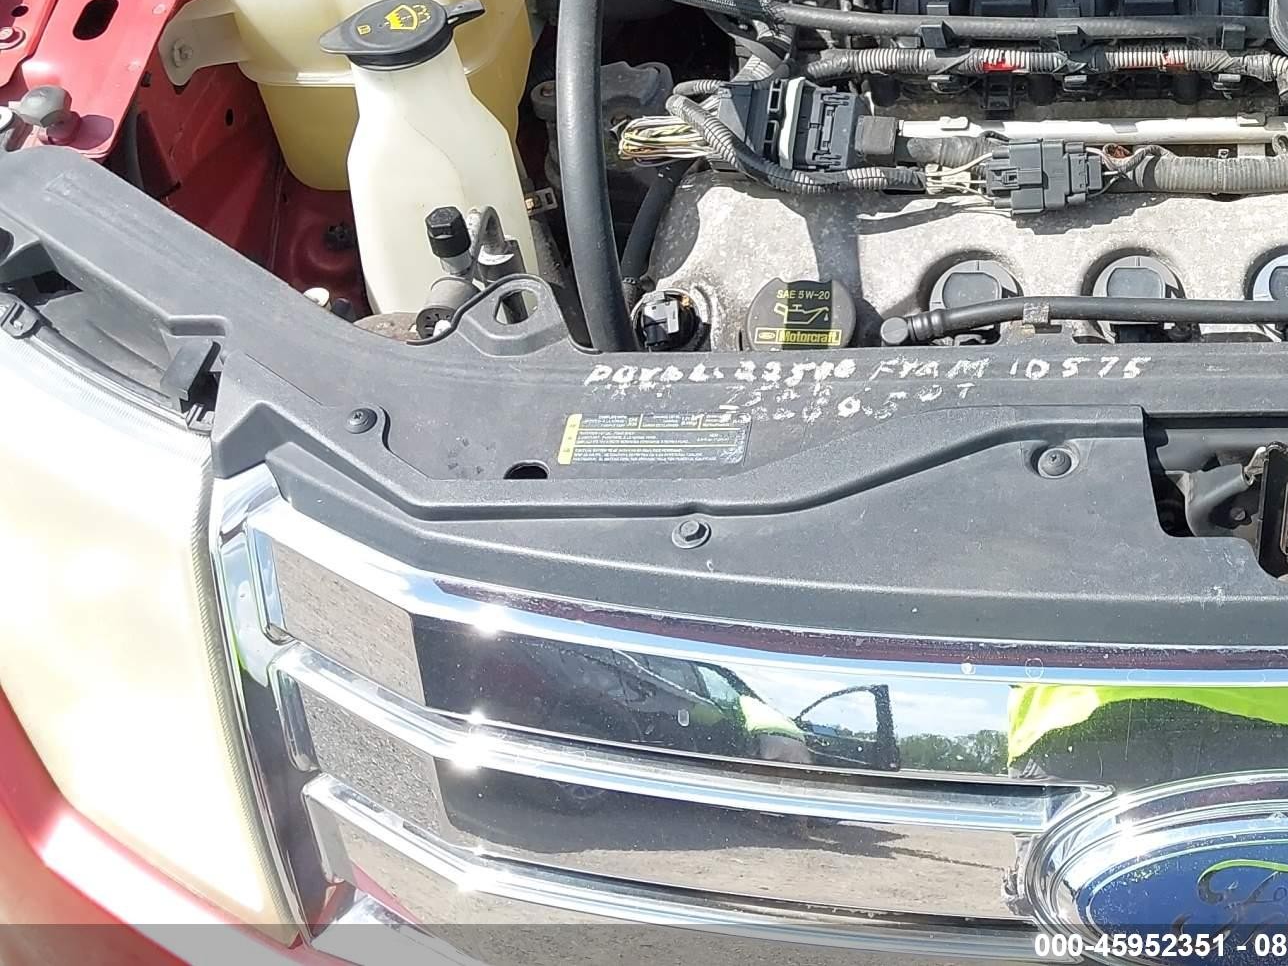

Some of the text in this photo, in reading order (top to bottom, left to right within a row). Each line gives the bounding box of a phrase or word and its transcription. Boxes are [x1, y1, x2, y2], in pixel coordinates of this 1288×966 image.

[776, 289, 831, 300] SAE 5W-20
[778, 330, 838, 343] Motorcraft
[1008, 356, 1152, 380] 10575
